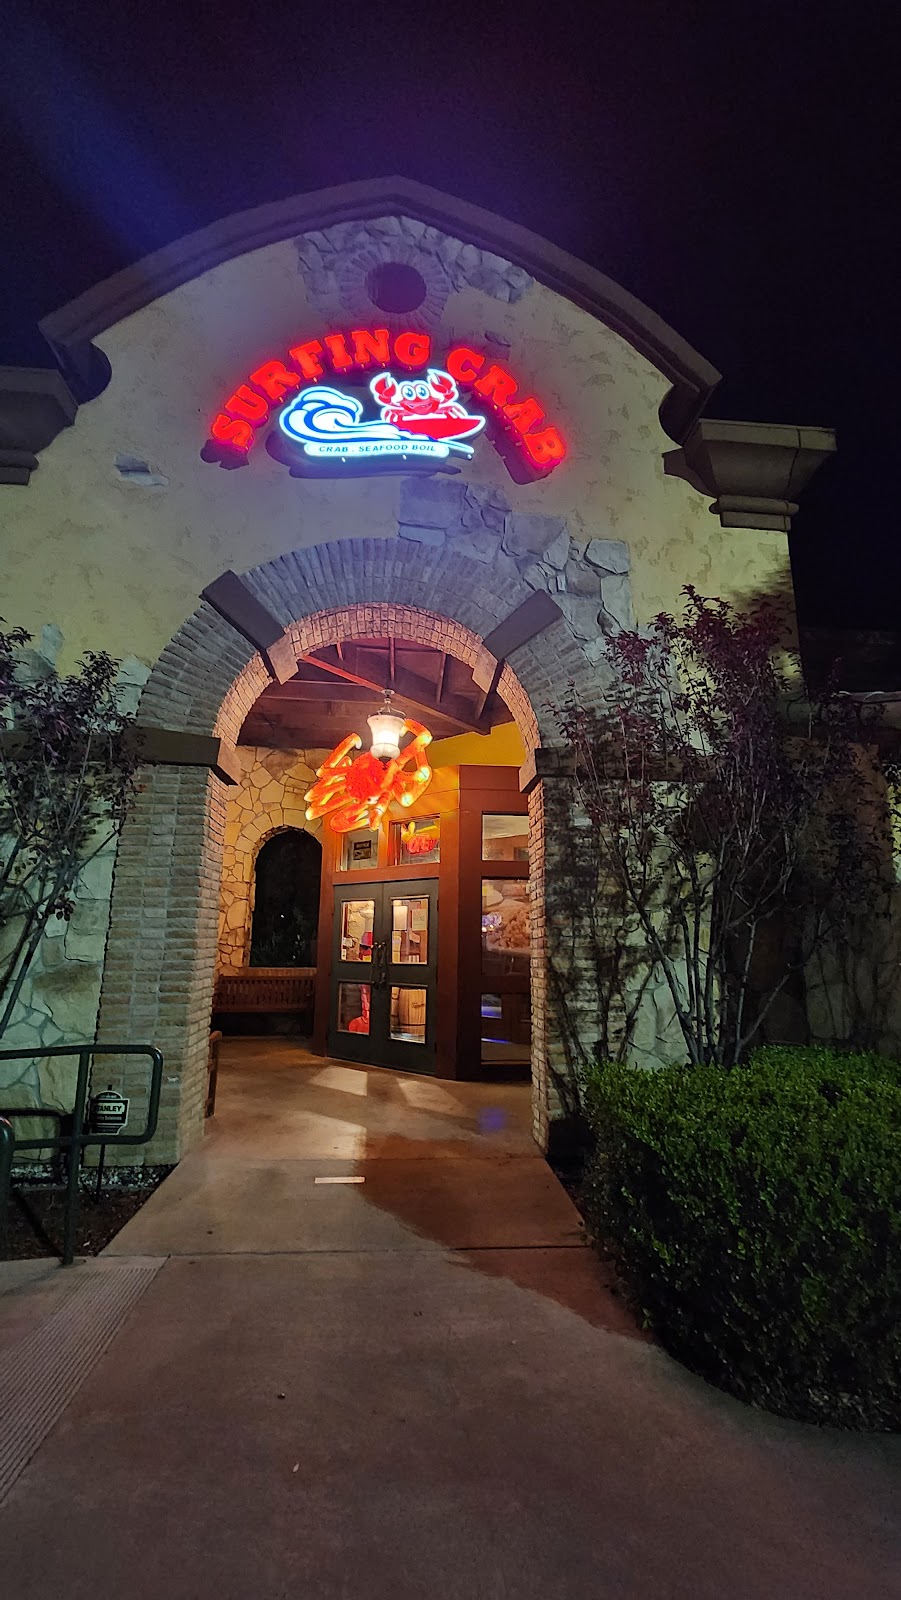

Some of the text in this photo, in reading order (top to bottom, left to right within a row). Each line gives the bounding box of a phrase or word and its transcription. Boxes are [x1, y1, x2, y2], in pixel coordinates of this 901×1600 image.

[211, 329, 566, 465] SURFING CRAB
[358, 444, 408, 452] SEAFOOD
